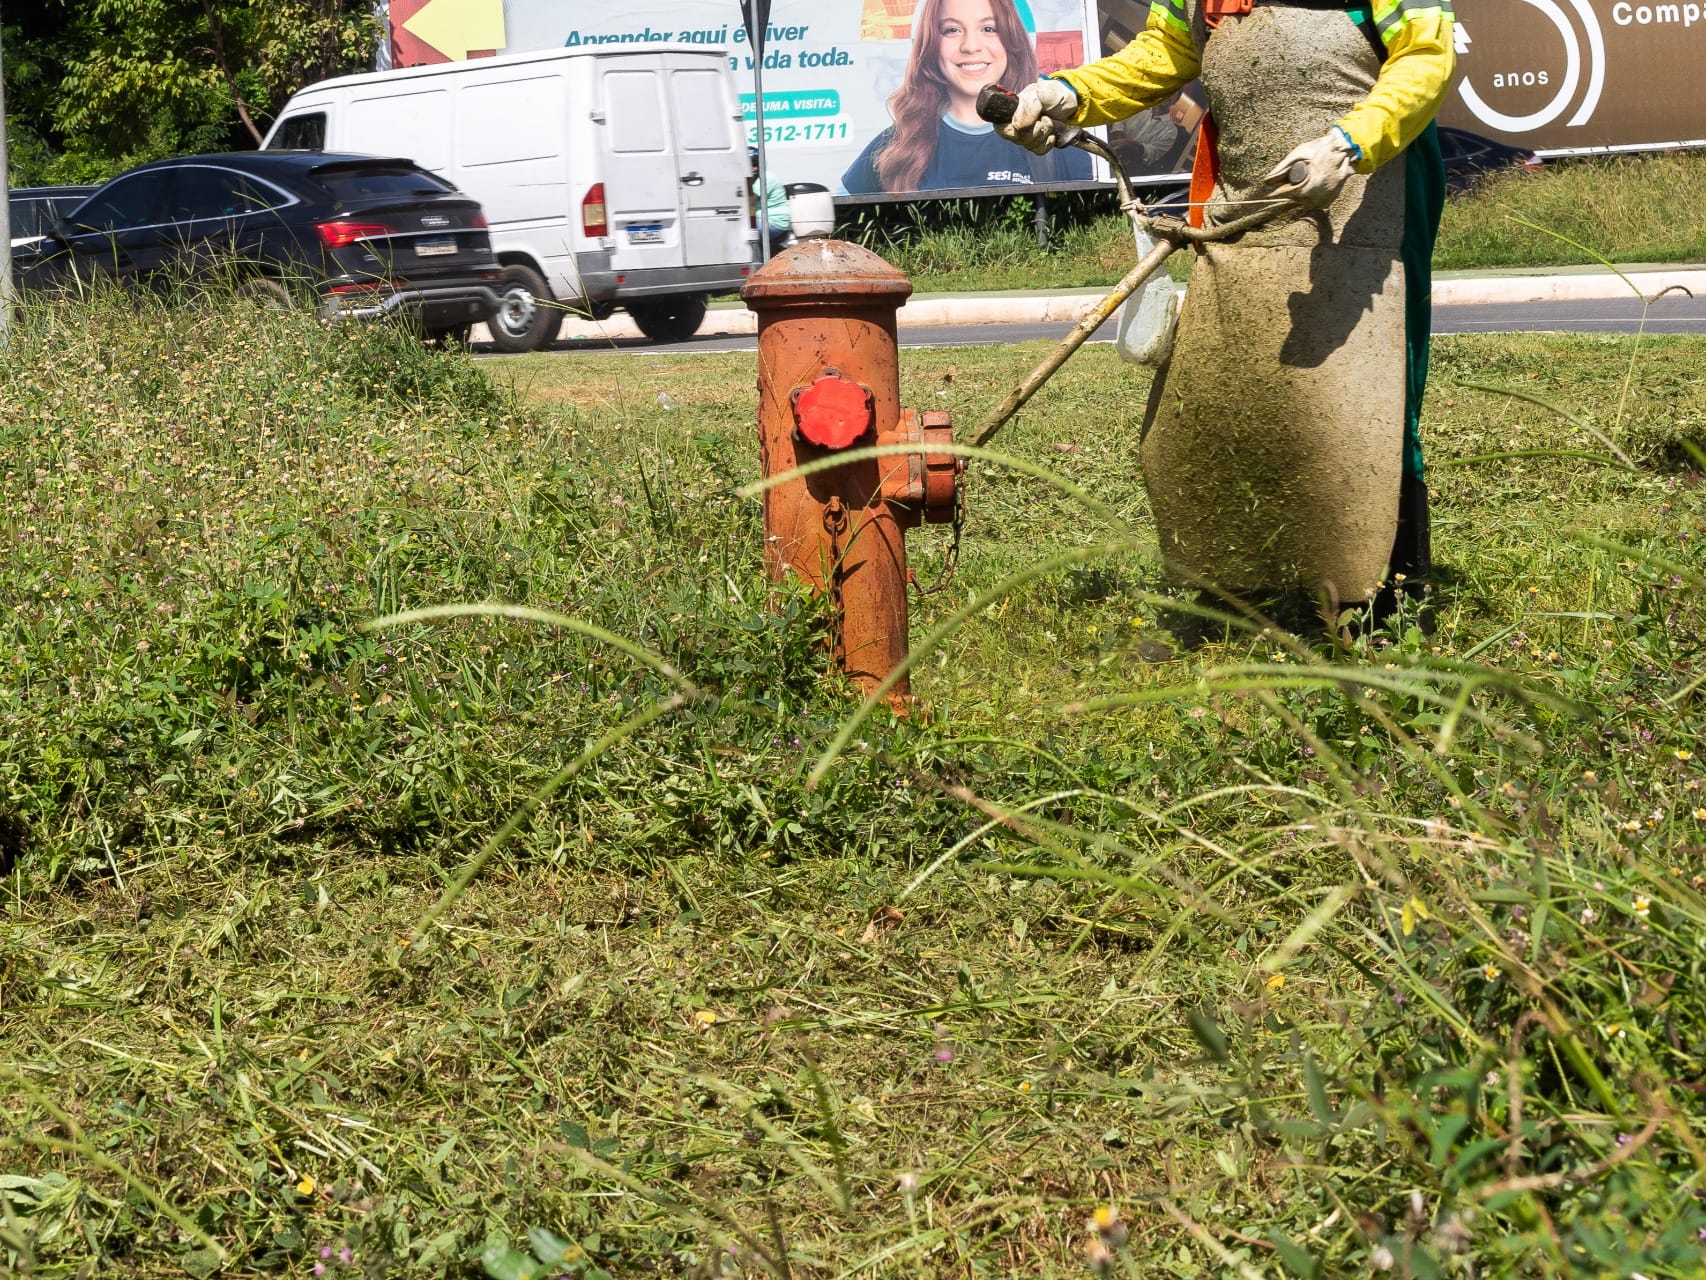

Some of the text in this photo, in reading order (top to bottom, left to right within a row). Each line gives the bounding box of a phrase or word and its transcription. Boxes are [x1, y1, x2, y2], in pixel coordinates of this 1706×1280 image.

[1612, 1, 1706, 28] Comp
[765, 22, 809, 42] iver
[745, 49, 792, 71] vda
[798, 46, 855, 68] toda.
[1493, 70, 1550, 89] anos
[763, 100, 790, 112] UMA
[794, 98, 837, 110] VISITA:
[986, 170, 1012, 181] SESI
